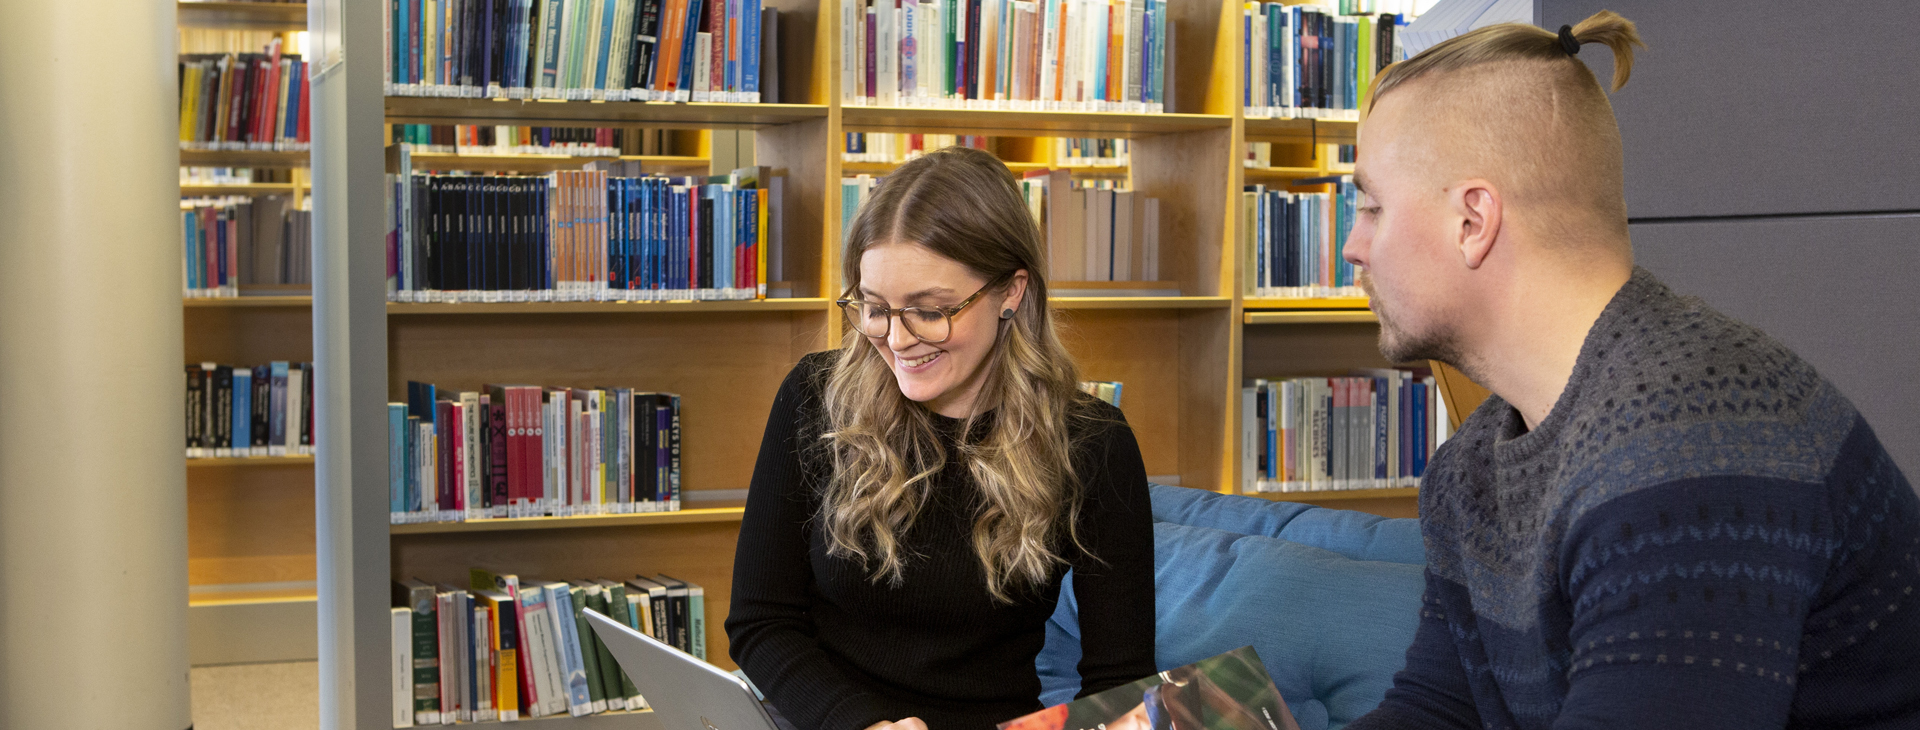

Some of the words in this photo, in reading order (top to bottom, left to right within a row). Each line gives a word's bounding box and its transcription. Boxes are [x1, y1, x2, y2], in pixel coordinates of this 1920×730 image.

[906, 6, 914, 47] ADDING
[714, 2, 723, 74] MATHEMATICS
[906, 50, 914, 62] IT
[906, 65, 914, 80] UP
[672, 415, 680, 440] KEYS
[672, 444, 680, 454] TO
[1320, 461, 1326, 473] OF
[671, 458, 680, 501] INFINITY
